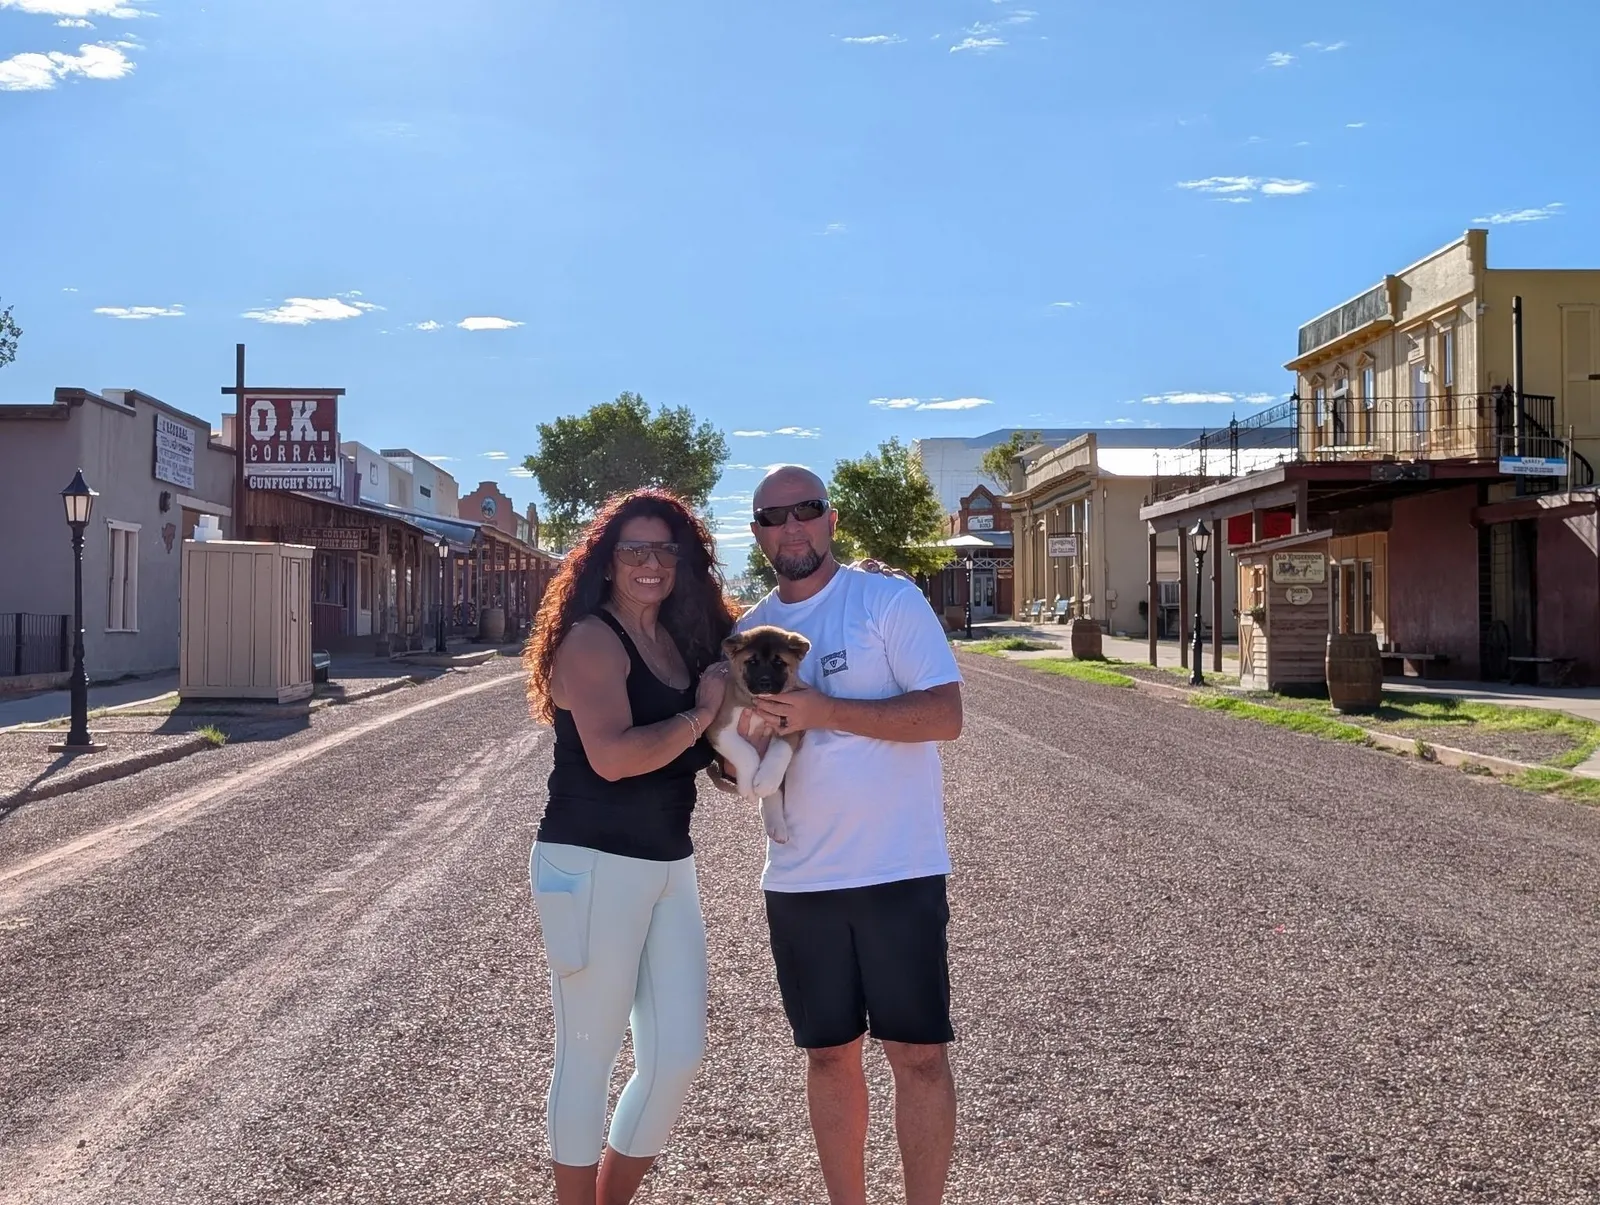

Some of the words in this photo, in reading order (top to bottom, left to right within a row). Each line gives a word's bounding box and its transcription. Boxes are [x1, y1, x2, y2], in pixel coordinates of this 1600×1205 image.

[249, 400, 330, 441] O.K.
[250, 444, 331, 462] CORRAL
[249, 475, 305, 490] GUNFIGHT
[306, 475, 332, 490] SITE
[322, 530, 359, 539] CORRAL
[341, 539, 359, 548] SITE
